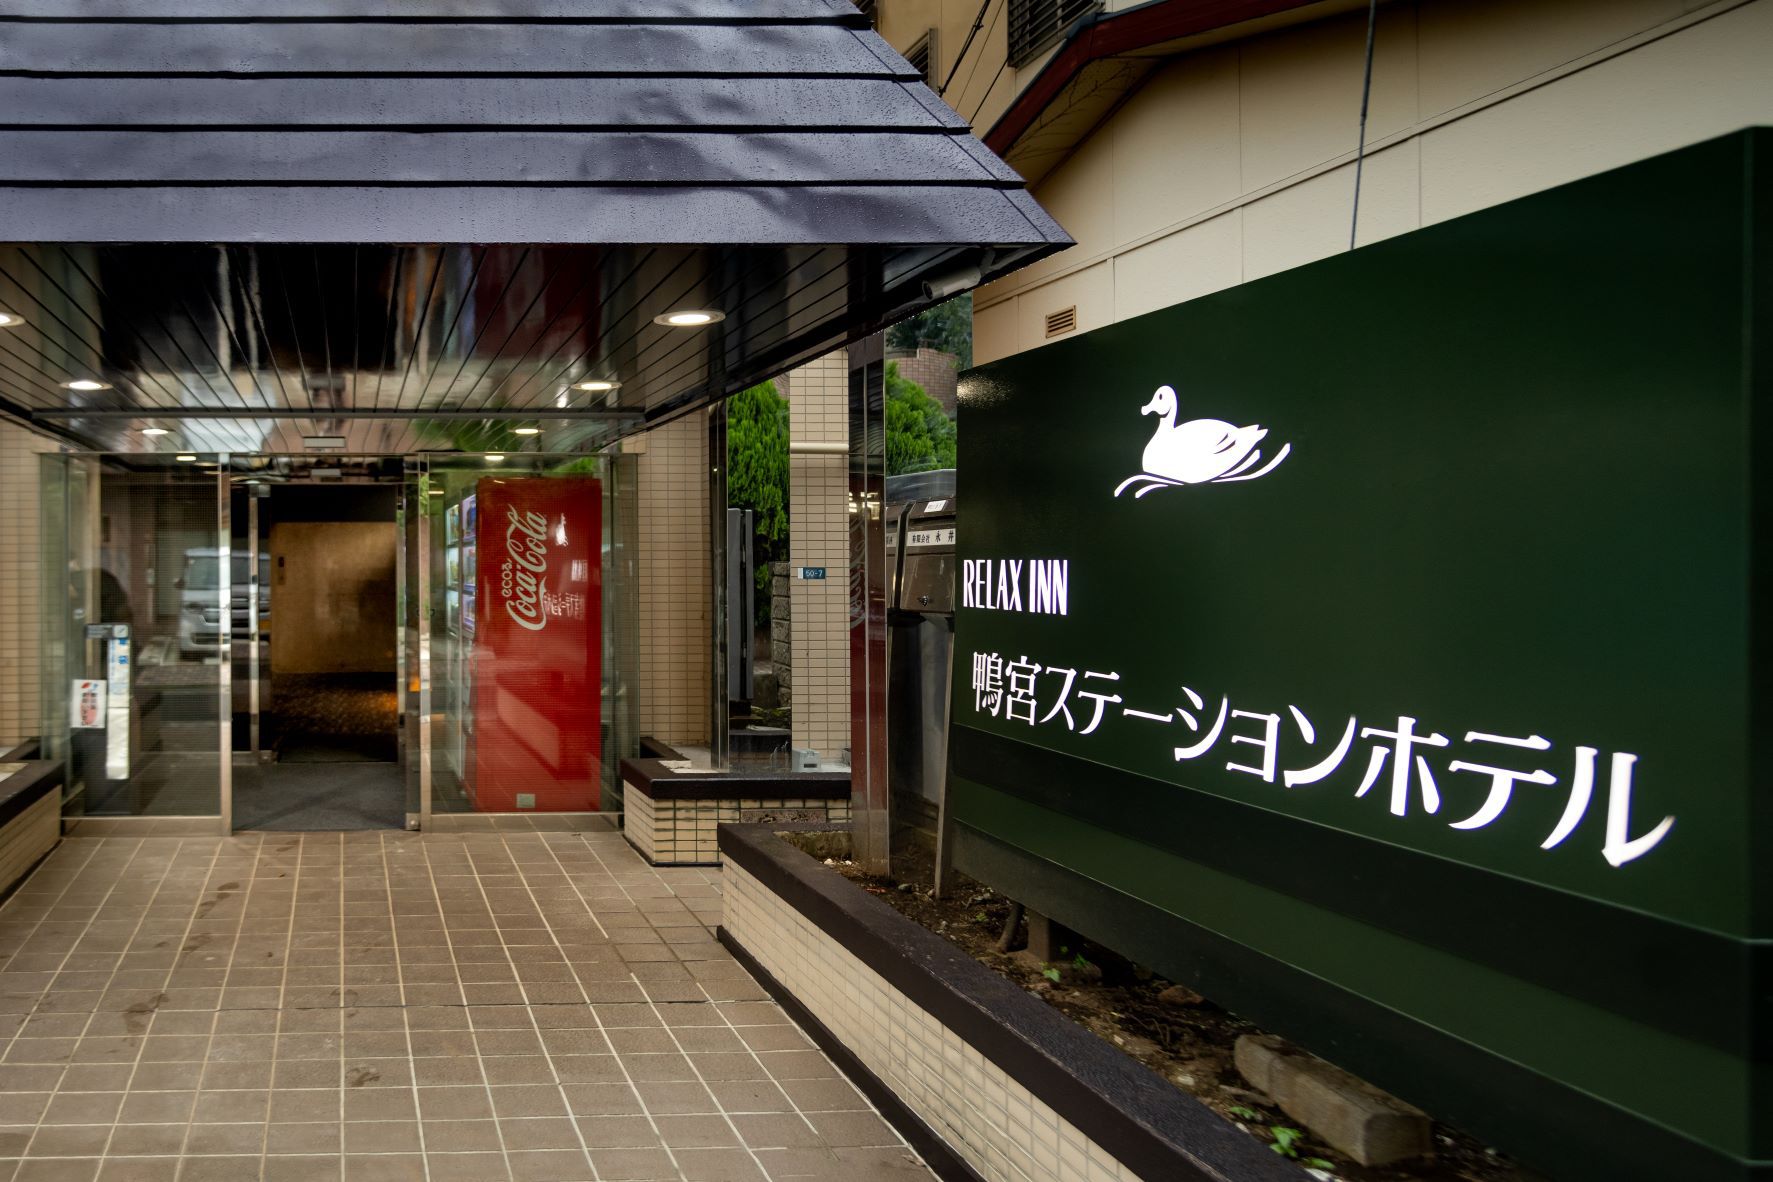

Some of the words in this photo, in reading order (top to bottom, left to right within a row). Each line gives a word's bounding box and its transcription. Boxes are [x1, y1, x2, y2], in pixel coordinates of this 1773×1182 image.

[506, 503, 547, 631] Coca-Cola
[963, 559, 1023, 612] RELAX
[1029, 559, 1068, 616] INN
[972, 651, 1676, 868] 鴨宮ステーションホテル
